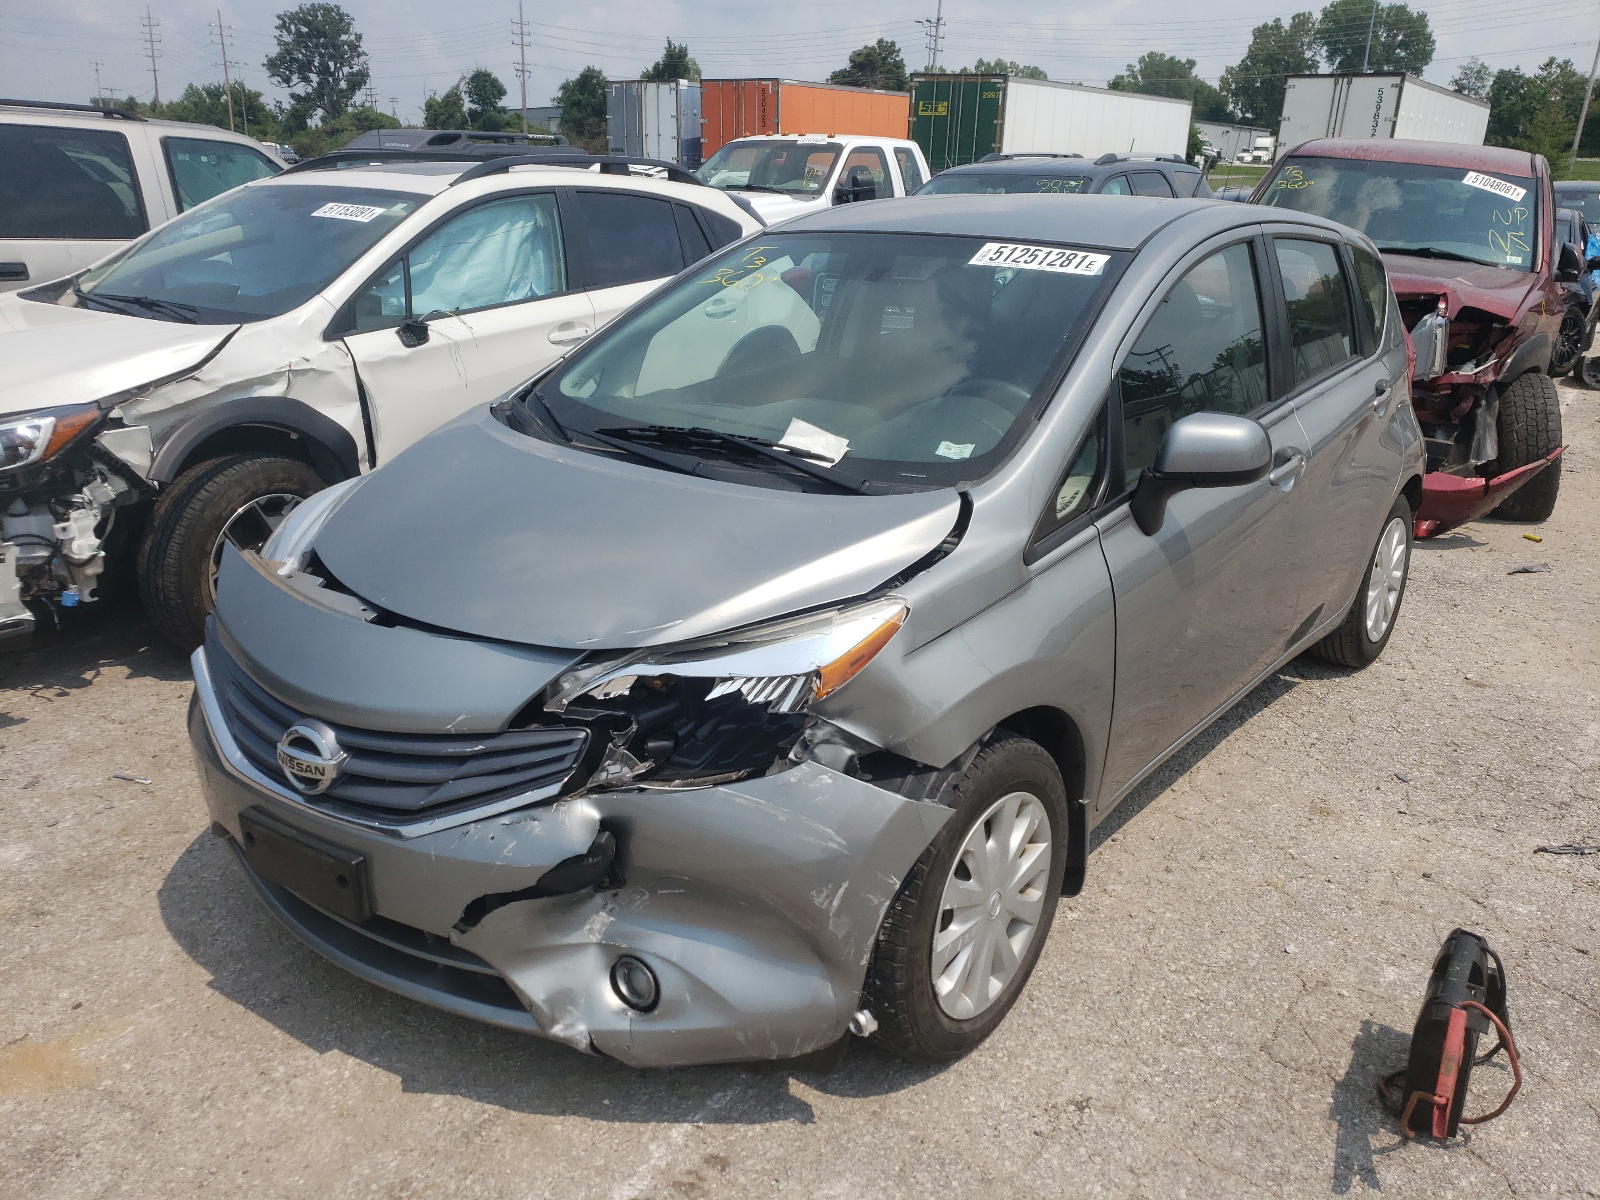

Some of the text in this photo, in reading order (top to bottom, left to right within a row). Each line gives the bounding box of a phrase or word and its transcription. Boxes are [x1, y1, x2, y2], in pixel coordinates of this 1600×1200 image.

[1371, 87, 1384, 137] 539832
[1472, 174, 1517, 197] 51048081
[989, 245, 1089, 269] 51251281
[1086, 260, 1097, 269] E
[278, 751, 326, 777] NISSAN
